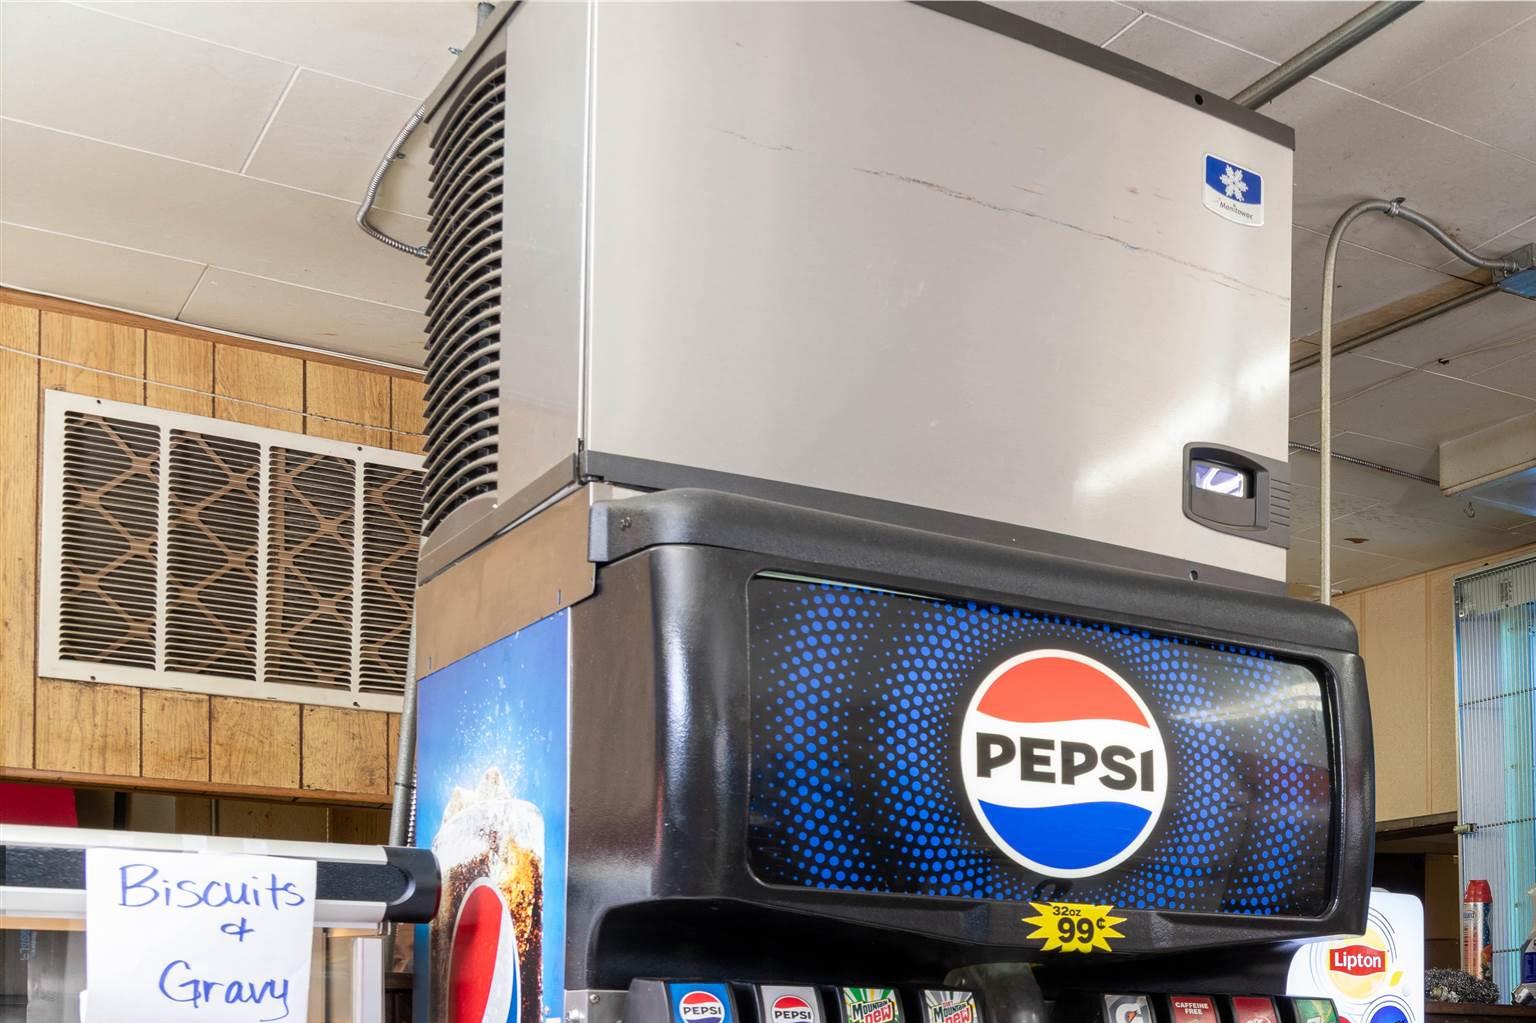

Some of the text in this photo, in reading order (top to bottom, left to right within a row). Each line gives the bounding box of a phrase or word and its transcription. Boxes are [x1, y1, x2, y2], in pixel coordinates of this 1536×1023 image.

[975, 731, 1155, 793] PEPSI
[118, 863, 306, 911] Biscuits
[1052, 905, 1081, 918] 32oz
[1057, 916, 1106, 944] 99¢
[1334, 952, 1382, 970] Lipton
[158, 961, 290, 1022] Gravy
[682, 1005, 722, 1016] PEPSI
[774, 1009, 811, 1021] PEPSI
